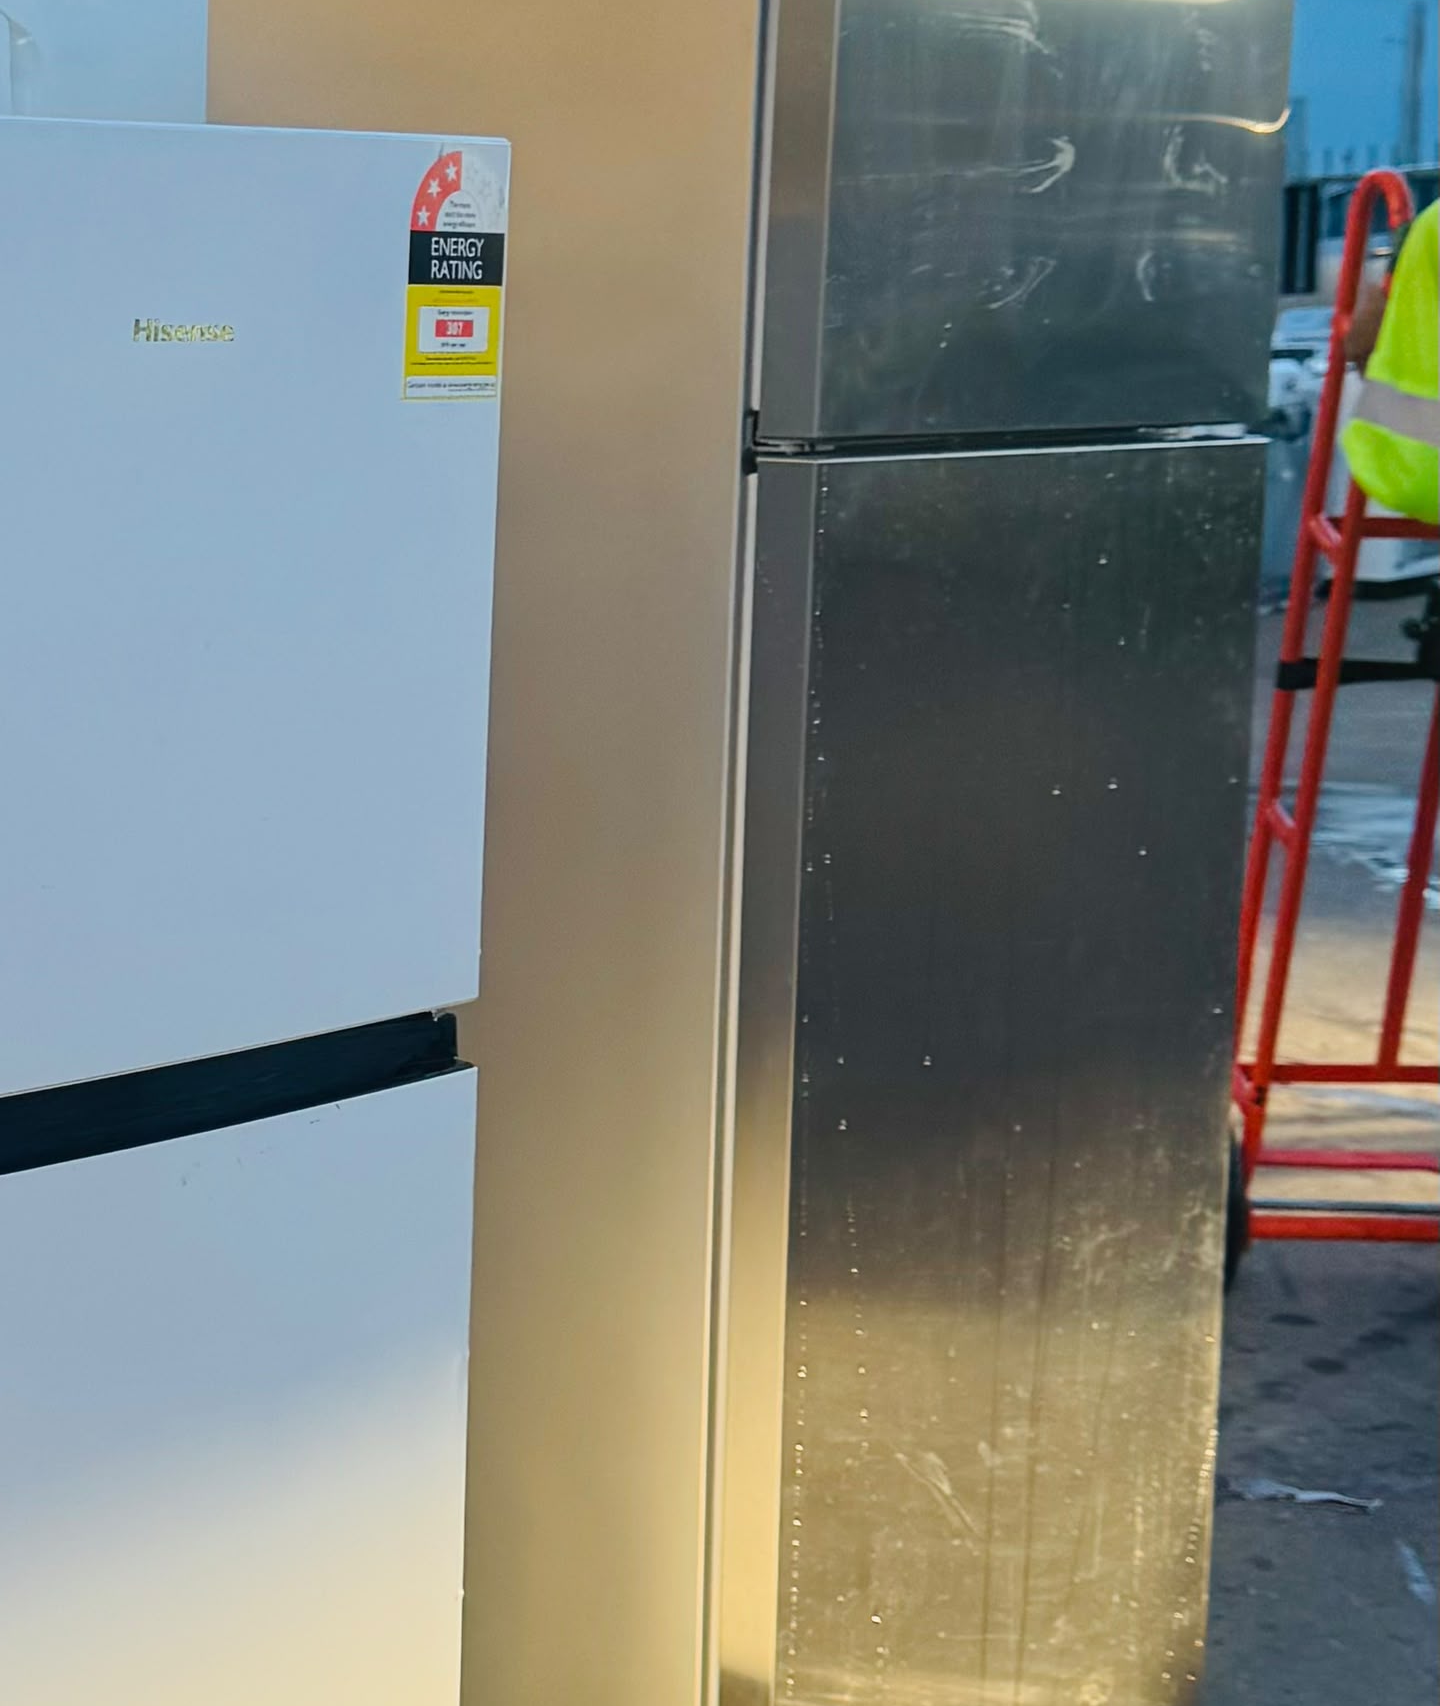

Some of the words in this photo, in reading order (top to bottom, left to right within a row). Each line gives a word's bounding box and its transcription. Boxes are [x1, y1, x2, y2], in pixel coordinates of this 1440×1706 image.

[431, 237, 484, 257] ENERGY
[431, 260, 483, 280] RATING
[133, 318, 235, 342] Hisense
